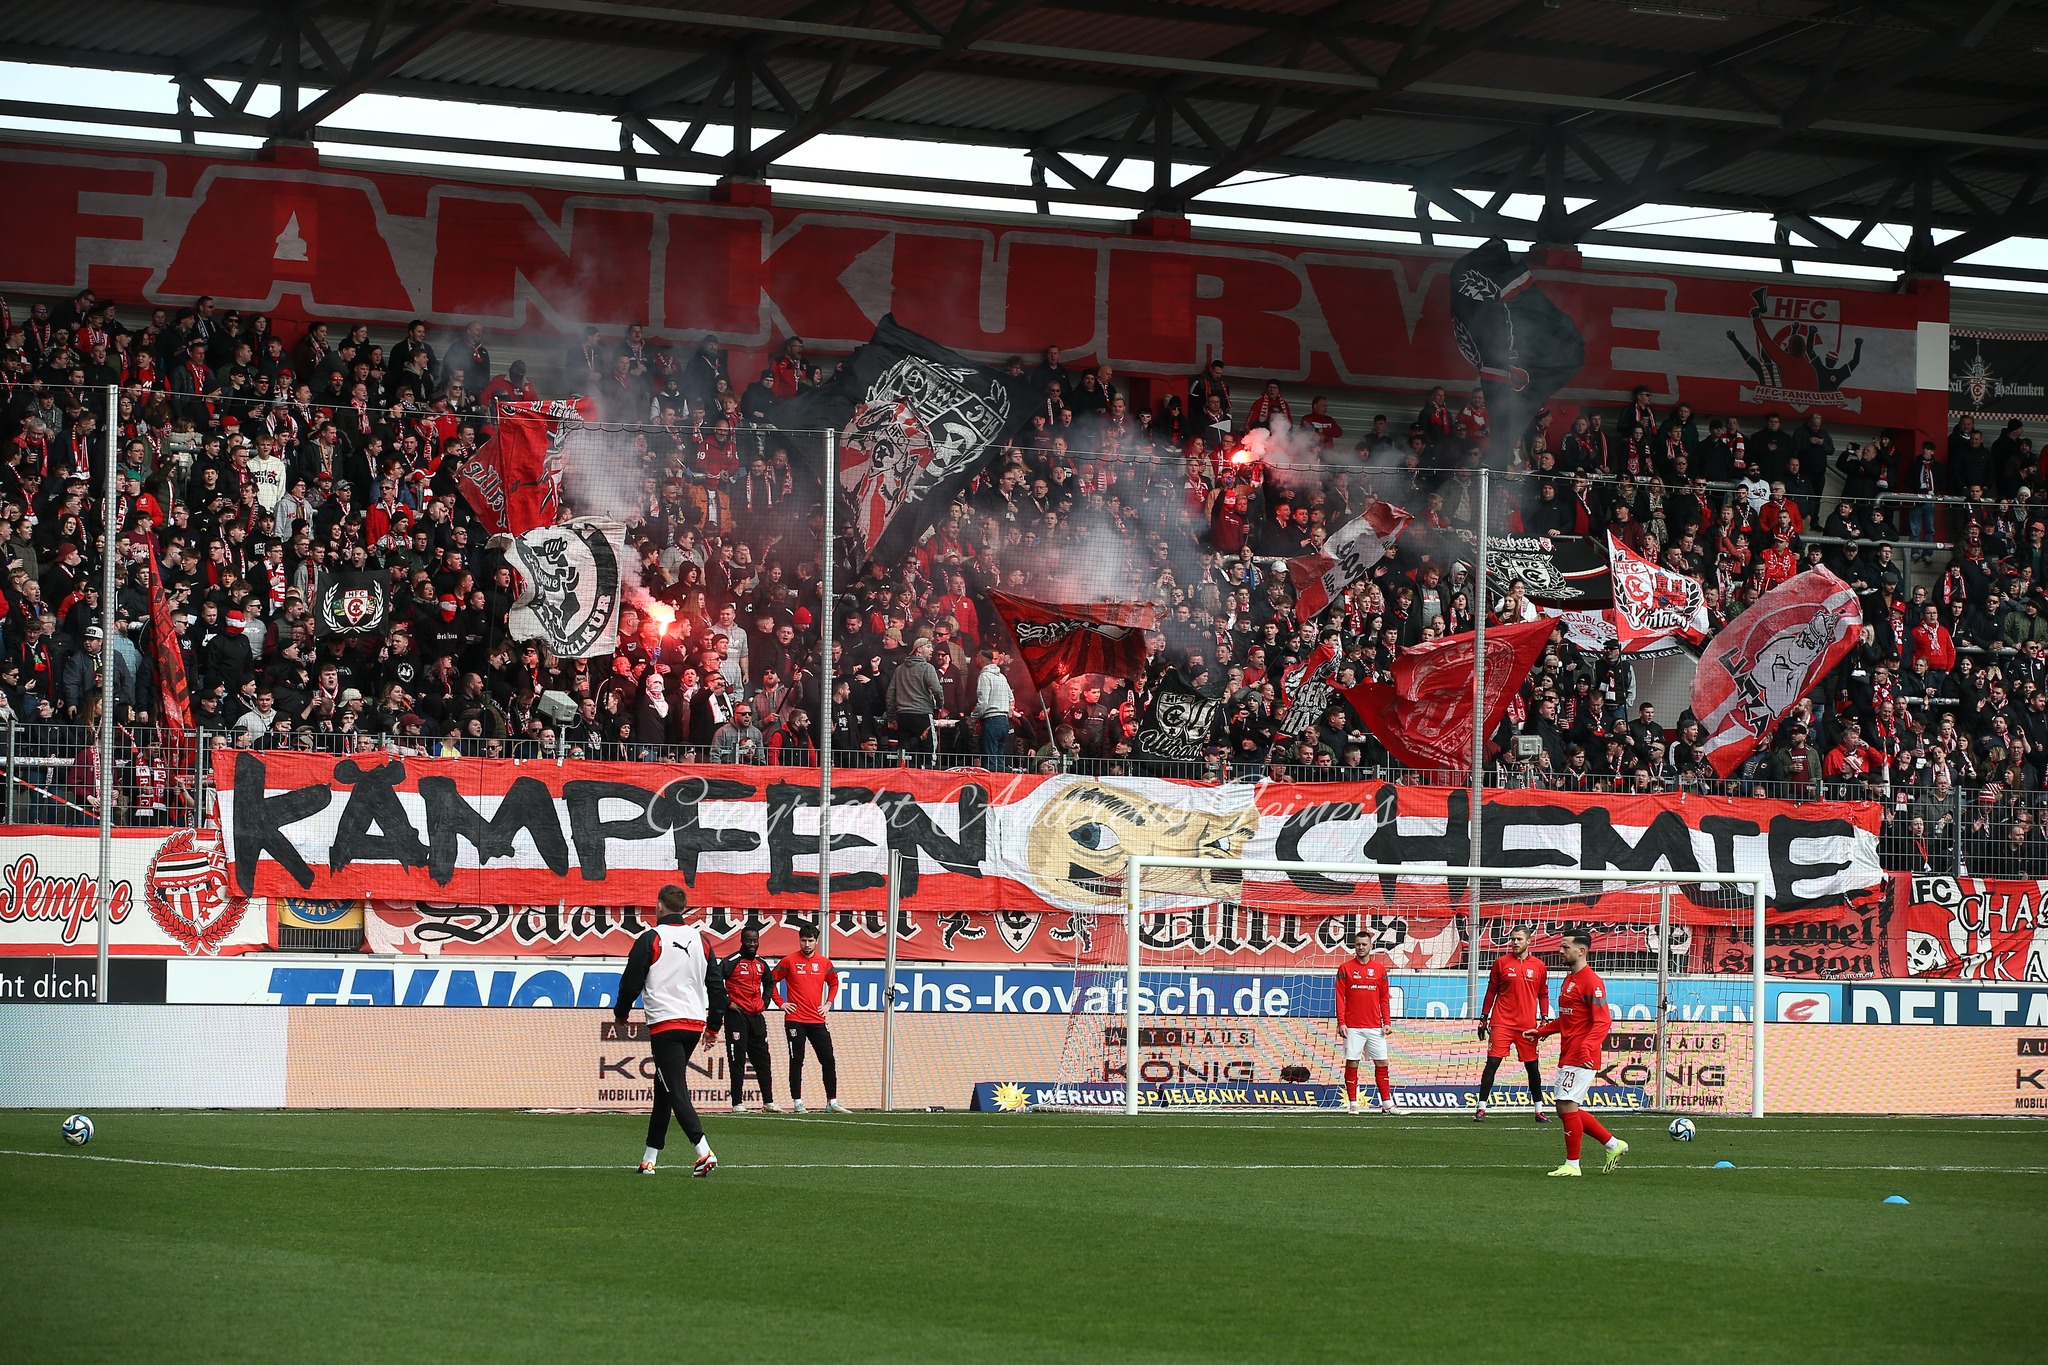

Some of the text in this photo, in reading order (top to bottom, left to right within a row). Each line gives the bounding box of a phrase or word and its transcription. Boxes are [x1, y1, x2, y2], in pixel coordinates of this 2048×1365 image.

[0, 148, 1680, 404] FANKURVE
[1775, 298, 1828, 319] HFC
[1756, 386, 1844, 401] HFC-FANKURVE
[1949, 379, 1963, 392] xil
[1619, 563, 1638, 573] HFC
[1641, 647, 1684, 660] SIEGEN
[233, 752, 988, 898] KÄMPFEN
[206, 851, 228, 869] HF
[0, 854, 133, 943] Sempe
[1916, 879, 1952, 903] FC
[1727, 916, 1876, 947] abbel
[33, 973, 97, 999] dich!
[833, 970, 1290, 1016] fuchs-kovatsch.de
[1109, 1032, 1250, 1046] ATOHAUS
[1607, 1036, 1721, 1050] UTOAUS
[600, 1056, 760, 1080] KNI
[1103, 1053, 1255, 1083] KÖNIG
[1564, 1071, 1576, 1088] 23
[598, 1088, 763, 1101] MOBILITÄ ITTELPNKT
[1035, 1088, 1317, 1107] MERKUR SPIELBANK HALLE
[1664, 1095, 1724, 1107] ITTELPUNKT
